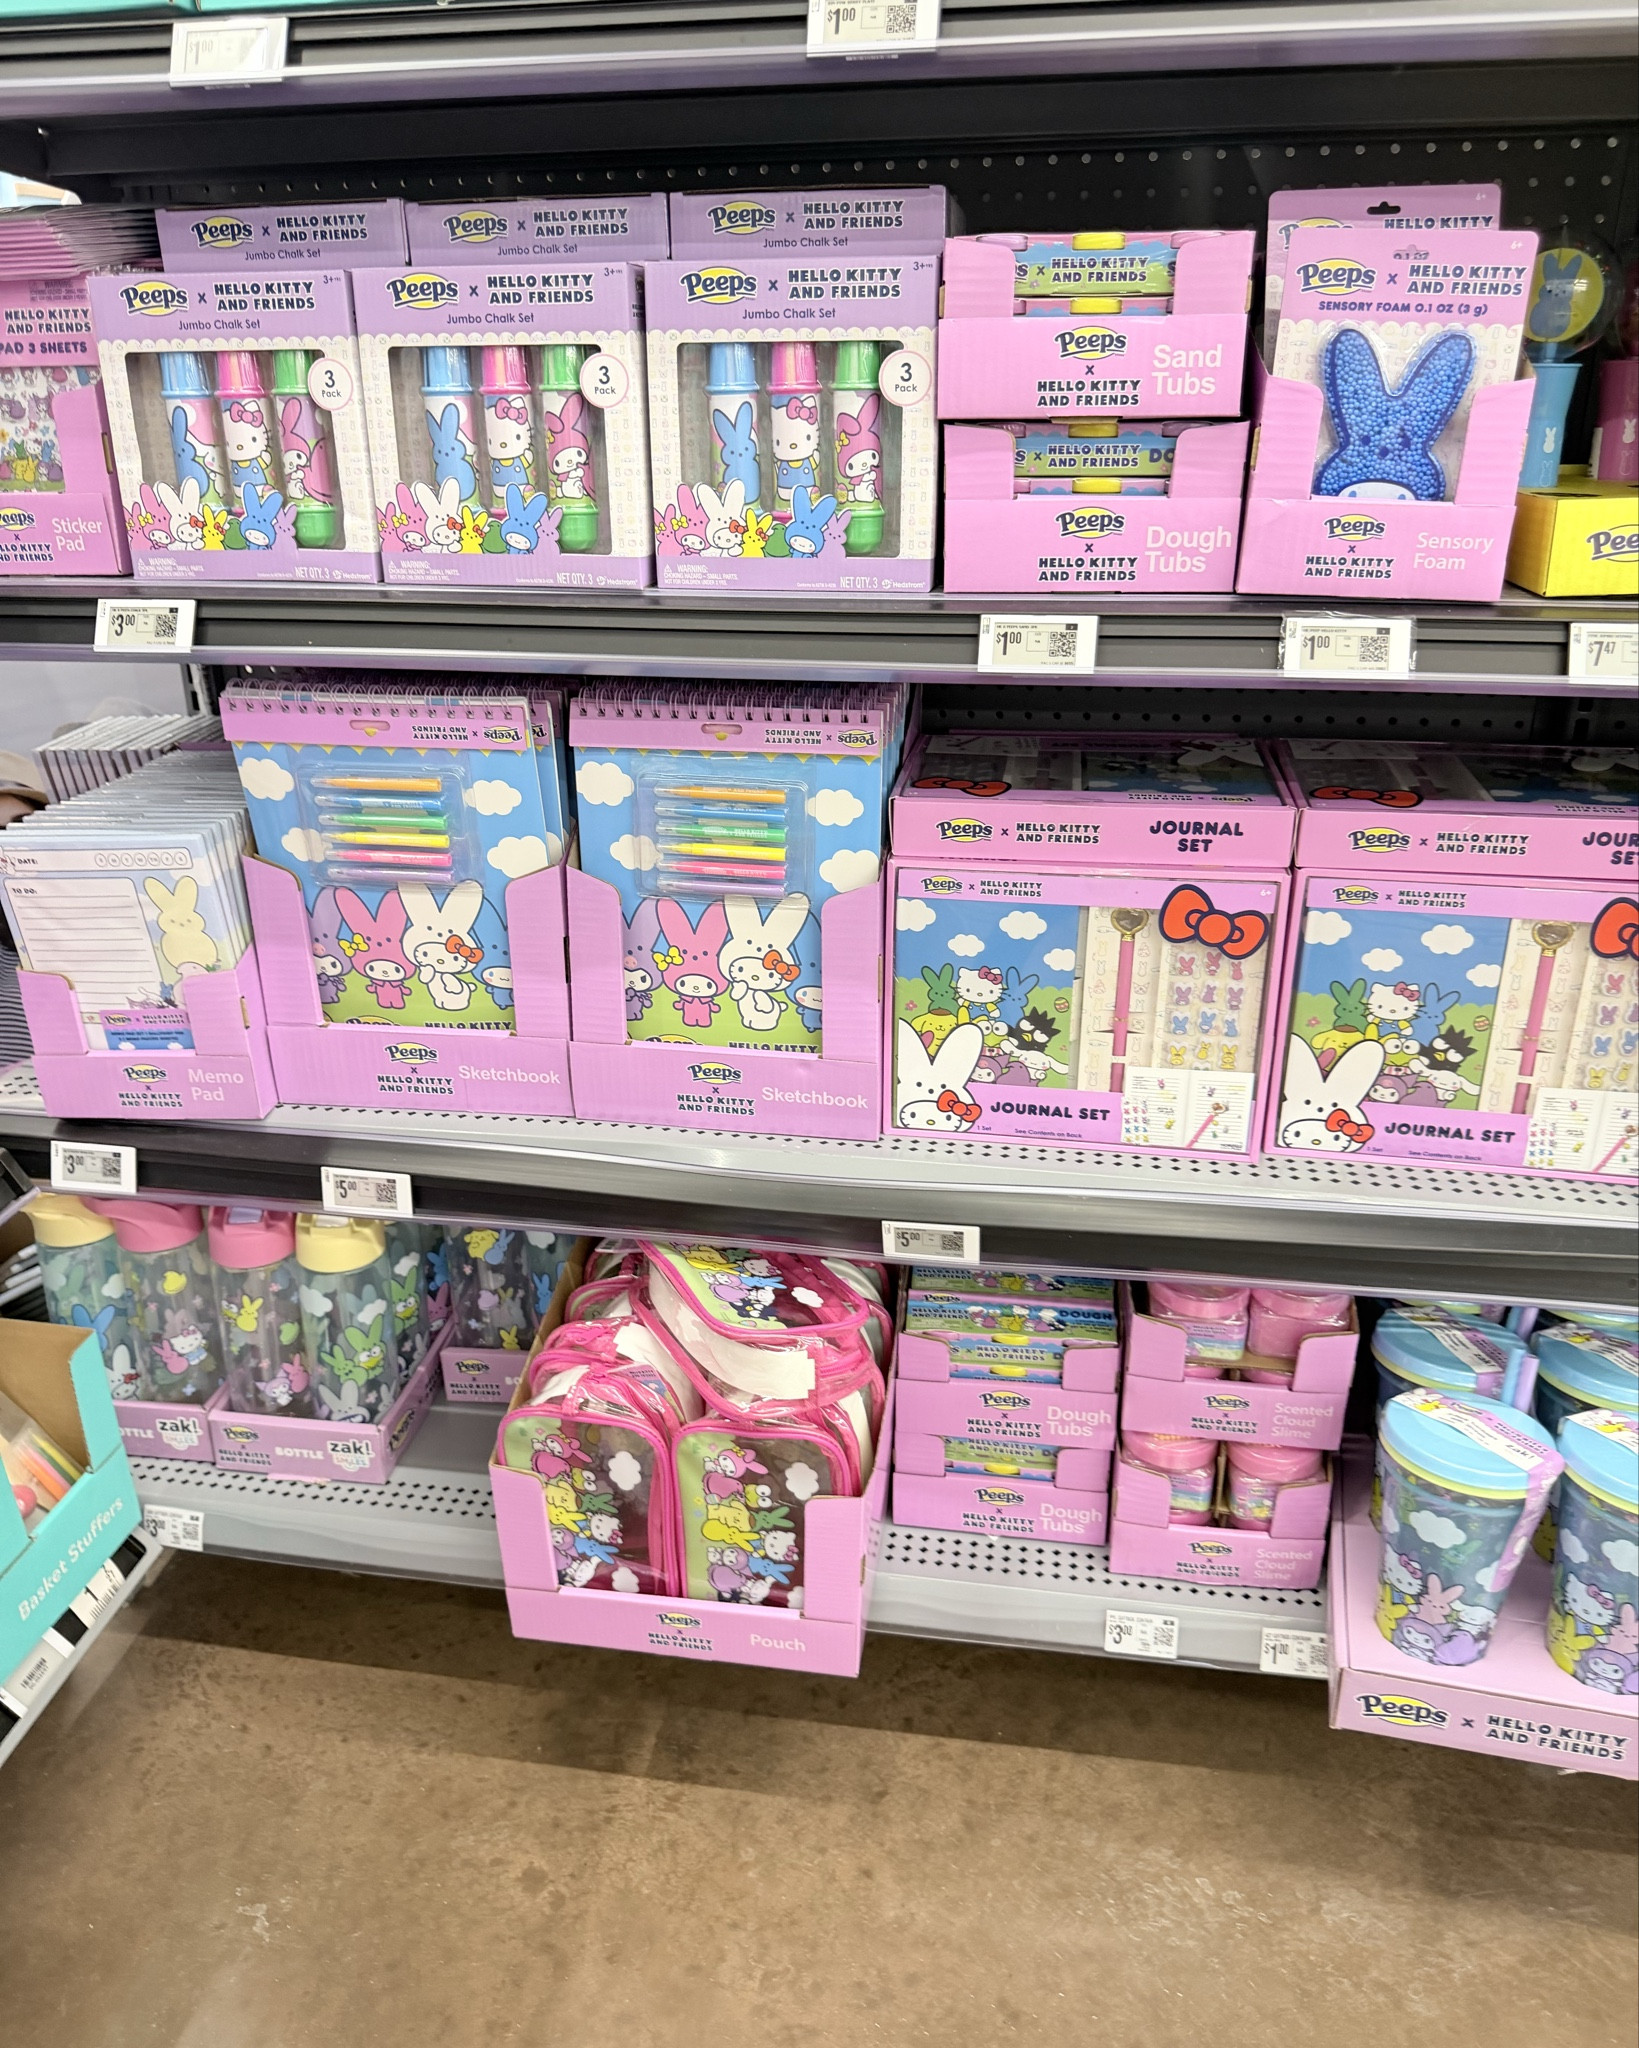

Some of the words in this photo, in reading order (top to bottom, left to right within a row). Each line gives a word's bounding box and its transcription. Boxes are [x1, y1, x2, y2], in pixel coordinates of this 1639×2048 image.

[533, 211, 578, 222] HELLO
[582, 208, 627, 220] KITTY
[803, 202, 850, 214] HELLO
[854, 201, 903, 214] KITTY
[708, 207, 776, 234] Peeps
[804, 217, 836, 229] AND
[841, 216, 902, 228] FRIENDS
[444, 216, 508, 242] Peeps
[763, 238, 798, 248] Jumbo
[800, 237, 831, 247] Chalk
[833, 237, 848, 246] Set
[788, 270, 840, 282] HELLO
[846, 268, 901, 281] KITTY
[1297, 266, 1376, 292] Peeps
[1409, 265, 1464, 279] HELLO
[1469, 266, 1527, 279] KITTY
[214, 283, 259, 295] HELLO
[265, 281, 313, 293] KITTY
[487, 275, 536, 288] HELLO
[541, 273, 593, 286] KITTY
[681, 272, 757, 300] Peeps
[1408, 281, 1445, 295] AND
[1451, 282, 1523, 295] FRIENDS
[121, 284, 188, 311] Peeps
[387, 279, 459, 307] Peeps
[489, 291, 522, 303] AND
[529, 290, 593, 302] FRIENDS
[790, 286, 824, 298] AND
[832, 285, 900, 297] FRIENDS
[5, 309, 44, 321] HELLO
[48, 309, 89, 320] KITTY
[742, 309, 780, 319] Jumbo
[782, 308, 816, 318] Chalk
[819, 308, 835, 318] Set
[1319, 301, 1374, 313] SENSORY
[1376, 302, 1412, 313] FOAM
[1415, 303, 1433, 313] 0.1
[1437, 304, 1454, 314] OZ
[447, 313, 481, 324] Jumbo
[485, 313, 518, 323] Chalk
[519, 312, 535, 323] Set
[7, 323, 34, 334] AND
[39, 322, 91, 333] FRIENDS
[29, 343, 36, 353] 3
[40, 341, 87, 353] SHEETS
[1055, 332, 1126, 357] Peeps
[1152, 345, 1223, 368] Sand
[325, 370, 336, 386] 3
[599, 366, 610, 383] 3
[900, 362, 912, 382] 3
[594, 386, 617, 395] Pack
[894, 384, 917, 392] Pack
[1038, 381, 1085, 392] HELLO
[1090, 380, 1141, 391] KITTY
[1152, 372, 1216, 395] Tubs
[322, 389, 342, 398] Pack
[52, 517, 103, 534] Sticker
[1056, 513, 1125, 536] Peeps
[1325, 520, 1385, 541] Peeps
[56, 536, 85, 551] Pad
[1147, 526, 1231, 552] Dough
[1416, 532, 1494, 552] Sensory
[1587, 530, 1639, 560] Pee
[1039, 557, 1085, 568] HELLO
[1089, 557, 1138, 567] KITTY
[1145, 552, 1206, 573] Tubs
[1306, 556, 1346, 567] HELLO
[1349, 557, 1394, 568] KITTY
[1414, 553, 1466, 570] Foam
[1305, 568, 1333, 578] AND
[1338, 569, 1392, 580] FRIENDS
[840, 577, 854, 588] NET
[856, 577, 872, 589] QTY.
[873, 577, 878, 587] 3
[765, 736, 792, 744] KITTY
[795, 736, 822, 745] HELLO
[838, 730, 877, 749] Peeps
[936, 821, 993, 841] Peeps
[1016, 823, 1056, 833] HELLO
[1060, 824, 1101, 834] KITTY
[1150, 821, 1243, 837] JOURNAL
[1016, 833, 1043, 843] AND
[1048, 834, 1099, 844] FRIENDS
[1178, 838, 1213, 853] SET
[1347, 832, 1410, 852] Peeps
[1436, 832, 1480, 843] HELLO
[1484, 834, 1529, 844] KITTY
[1610, 850, 1639, 865] SE
[921, 877, 963, 895] Peeps
[980, 880, 1008, 888] HELLO
[1012, 882, 1042, 890] KITTY
[385, 1043, 437, 1062] Peeps
[123, 1067, 167, 1084] Peeps
[188, 1069, 243, 1084] Memo
[458, 1064, 561, 1085] Sketchbook
[689, 1064, 742, 1083] Peeps
[118, 1092, 147, 1101] HELLO
[151, 1093, 181, 1101] KITTY
[191, 1087, 225, 1102] Pad
[677, 1095, 714, 1105] HELLO
[718, 1096, 754, 1106] KITTY
[761, 1086, 868, 1108] Sketchbook
[679, 1104, 703, 1114] AND
[707, 1106, 755, 1116] FRIENDS
[990, 1101, 1072, 1118] JOURNAL
[1078, 1107, 1110, 1121] SET
[1384, 1122, 1474, 1141] JOURNAL
[1481, 1128, 1514, 1143] SET
[1059, 1308, 1112, 1320] DOUGH
[979, 1390, 1030, 1408] Peeps
[1203, 1394, 1250, 1410] Peeps
[1047, 1407, 1112, 1428] Dough
[1274, 1402, 1334, 1418] Scented
[158, 1419, 198, 1438] zak!
[967, 1420, 1000, 1429] HELLO
[1004, 1421, 1042, 1431] KITTY
[1047, 1421, 1094, 1438] Tubs
[1273, 1415, 1316, 1428] Cloud
[1271, 1426, 1312, 1440] Slime
[275, 1445, 323, 1461] BOTTLE
[329, 1440, 371, 1458] zak!
[974, 1486, 1024, 1505] Peeps
[1040, 1504, 1102, 1524] Dough
[1040, 1518, 1086, 1534] Tubs
[18, 1559, 68, 1621] Basket
[68, 1497, 124, 1562] Stuffers
[655, 1613, 702, 1630] Peeps
[751, 1634, 806, 1652] Pouch
[1356, 1694, 1448, 1725] Peeps
[1487, 1715, 1553, 1736] HELLO
[1560, 1727, 1628, 1748] KITTY
[1487, 1728, 1529, 1745] AND
[1538, 1736, 1625, 1762] FRIENDS
